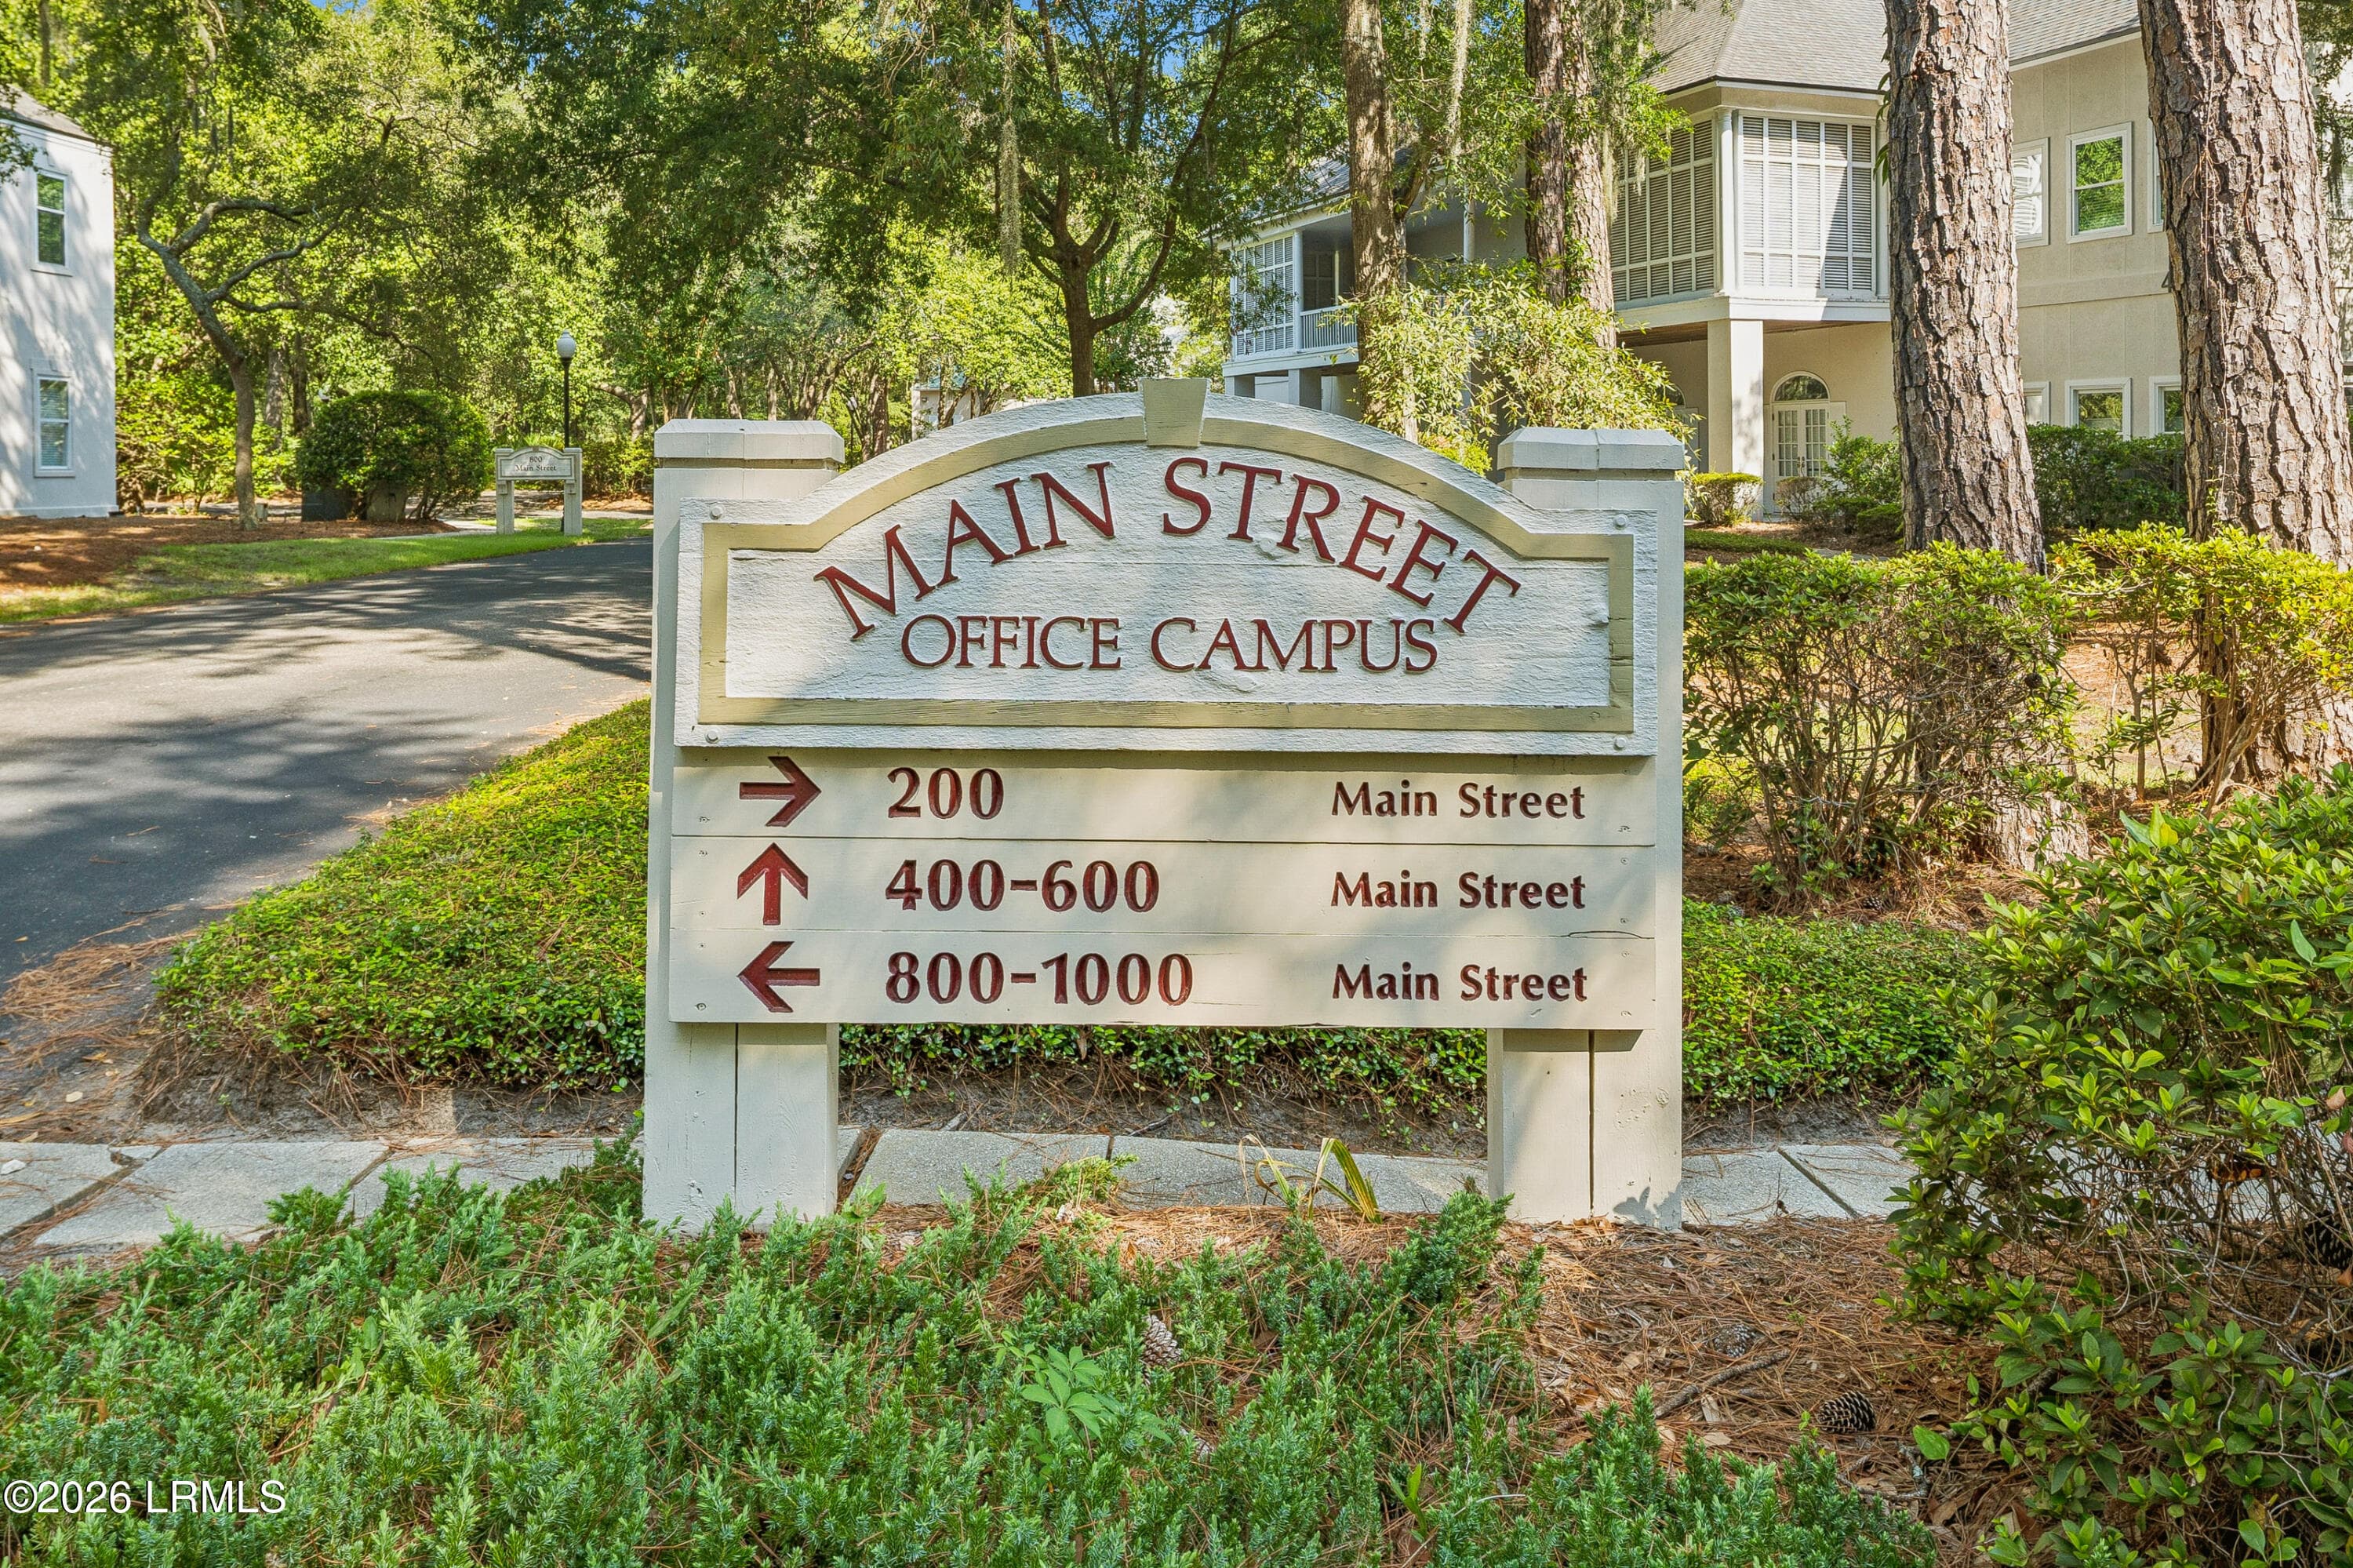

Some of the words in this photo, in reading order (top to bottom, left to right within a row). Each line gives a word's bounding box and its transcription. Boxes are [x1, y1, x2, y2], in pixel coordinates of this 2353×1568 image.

[813, 460, 1118, 641] MAIN
[1161, 456, 1522, 636] STREET
[900, 614, 1123, 671] OFFICE
[1150, 617, 1438, 675] CAMPUS
[887, 766, 1005, 820] 200
[1331, 779, 1438, 819] Main
[1457, 781, 1586, 820] Street
[884, 858, 1161, 914] 400-600
[1331, 869, 1438, 908] Main
[1457, 870, 1586, 910] Street
[885, 951, 1195, 1008] 800-1000
[1333, 962, 1440, 1002] Main
[1459, 962, 1587, 1002] Street
